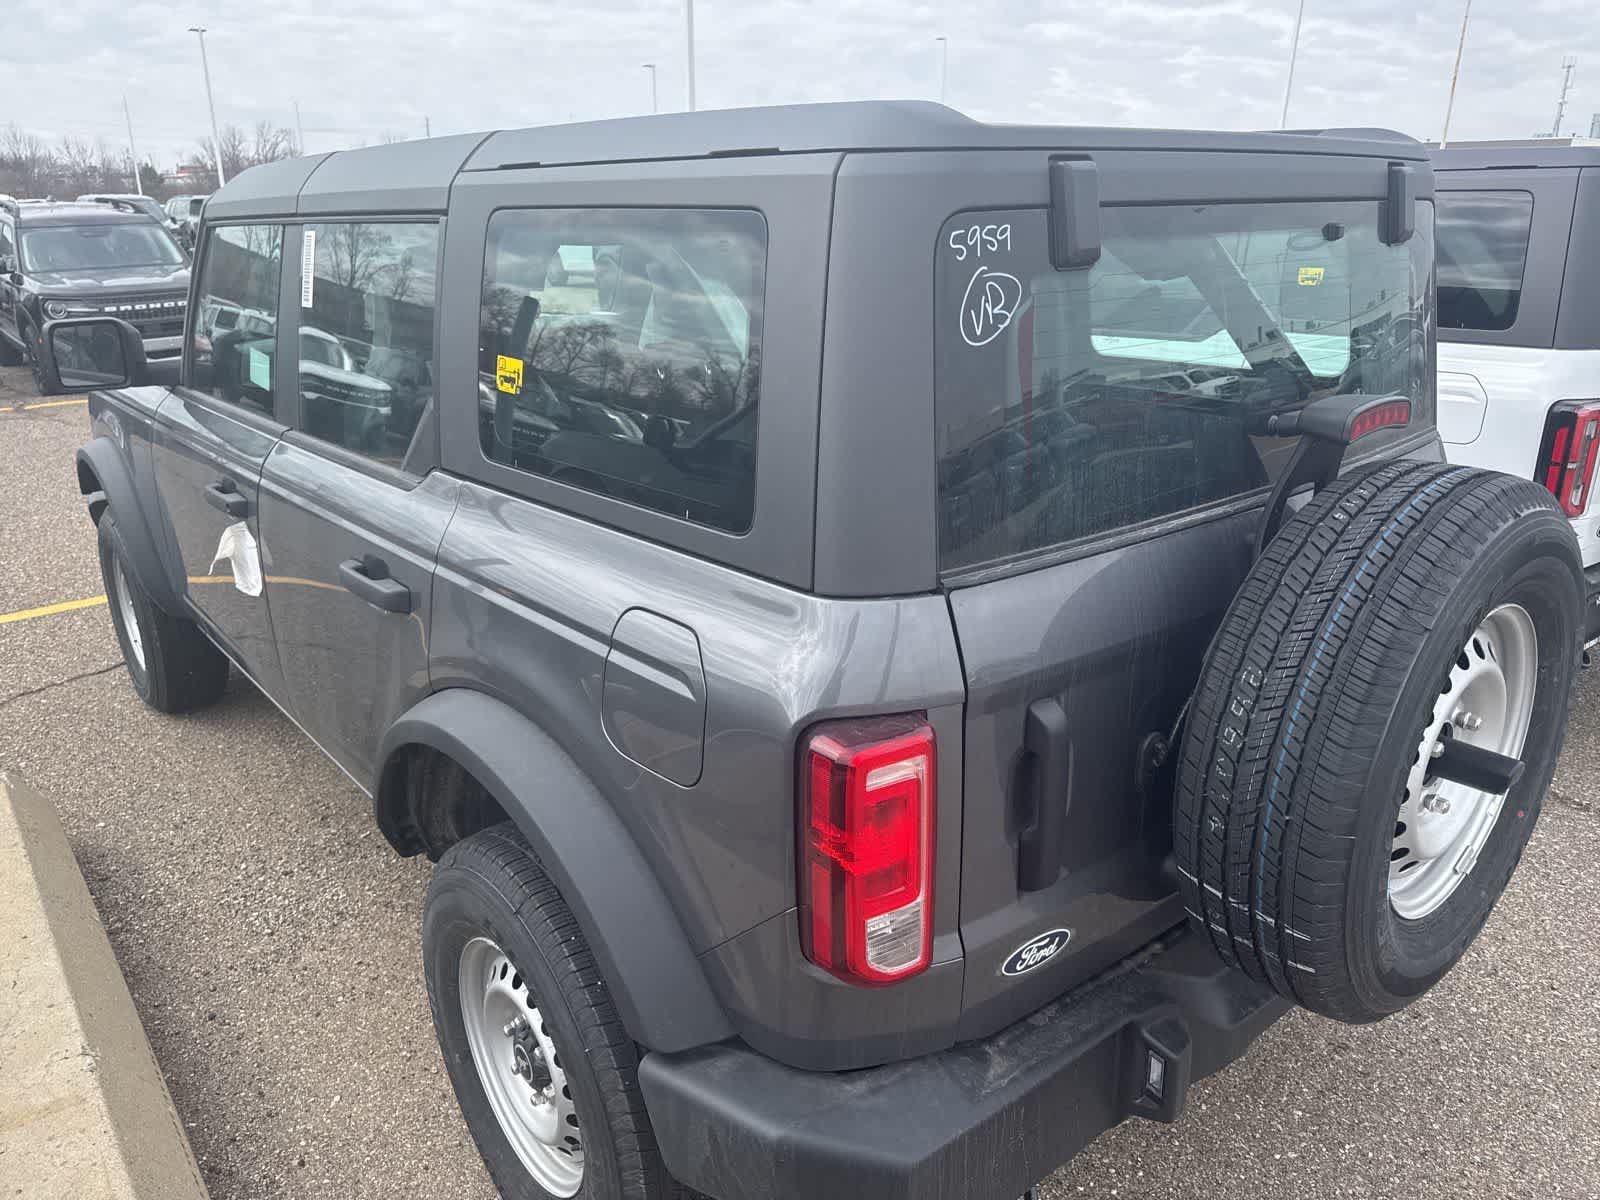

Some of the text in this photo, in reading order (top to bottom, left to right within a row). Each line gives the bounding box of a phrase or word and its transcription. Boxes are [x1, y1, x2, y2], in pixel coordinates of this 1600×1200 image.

[949, 224, 1011, 261] 5959
[104, 300, 188, 313] BRONCO
[1015, 936, 1060, 971] Ford
